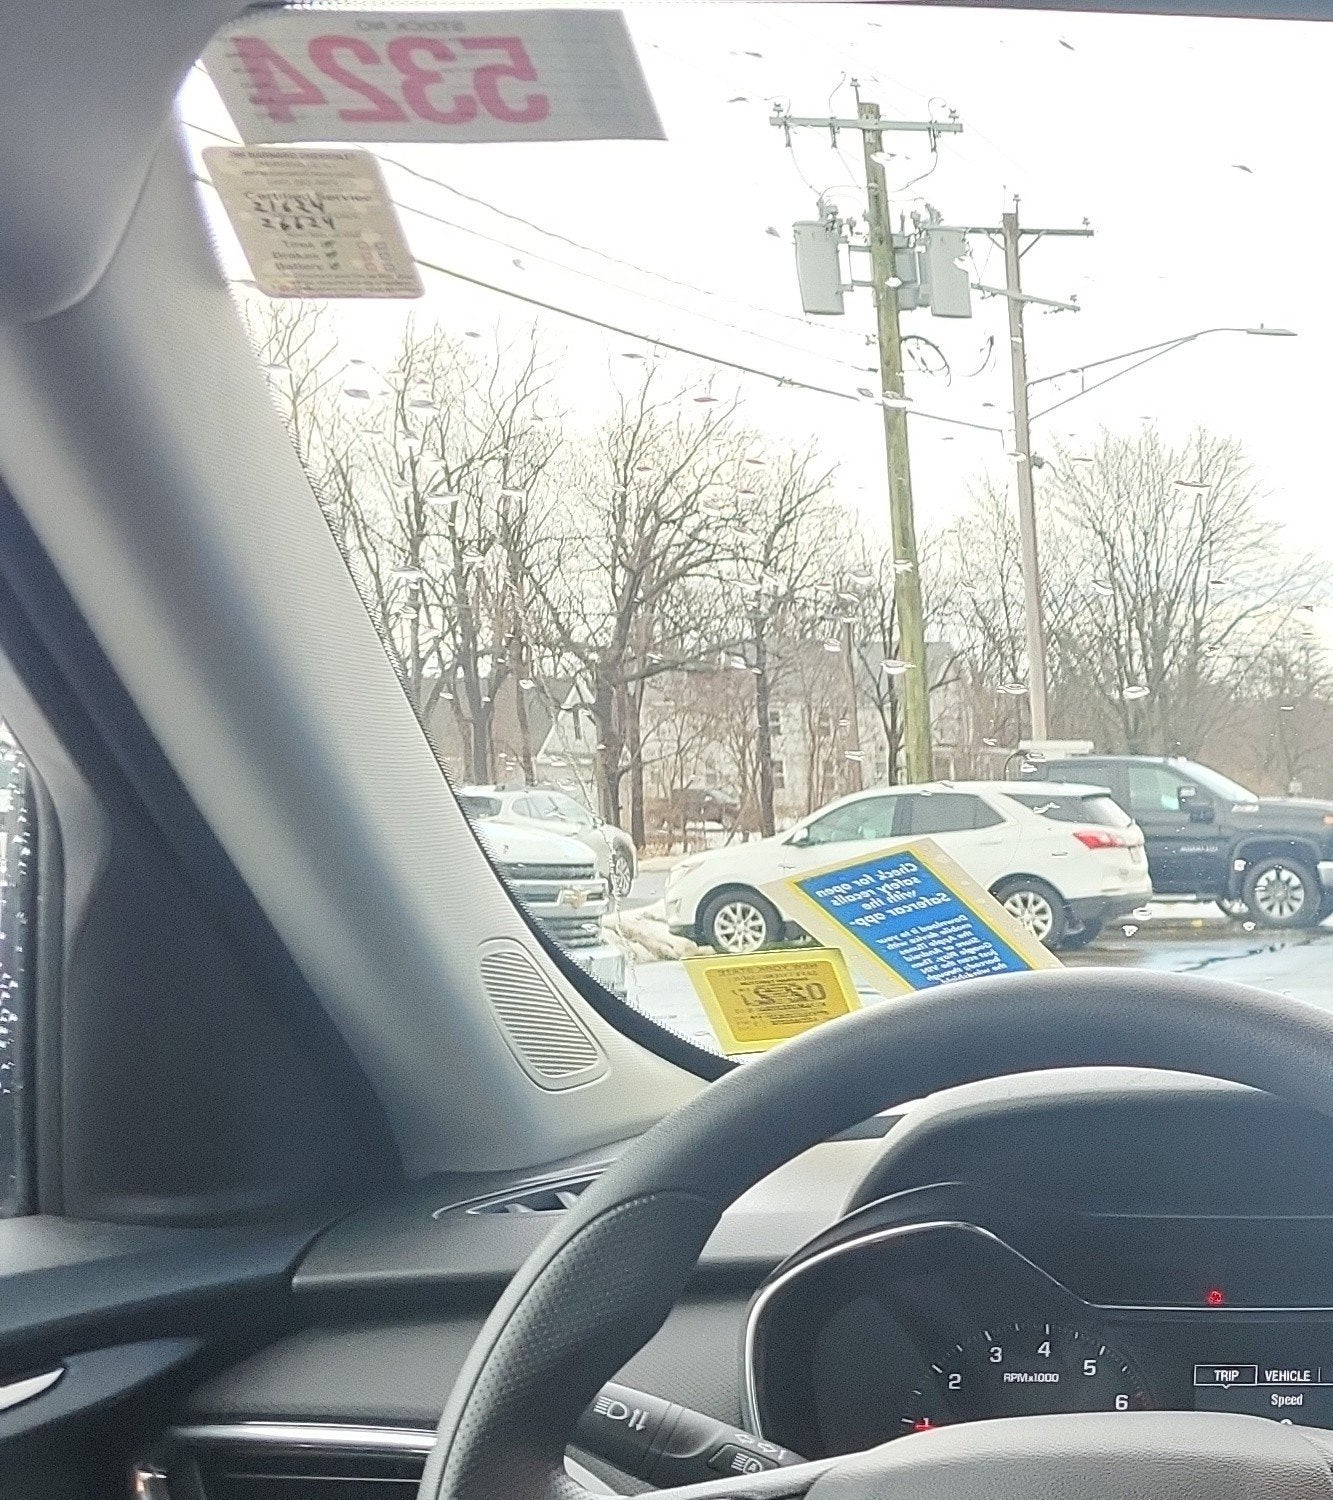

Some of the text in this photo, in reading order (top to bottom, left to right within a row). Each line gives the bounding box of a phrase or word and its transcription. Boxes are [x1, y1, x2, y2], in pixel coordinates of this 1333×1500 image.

[990, 1347, 1002, 1363] 3
[1038, 1342, 1051, 1357] 4
[1084, 1360, 1097, 1376] 5
[1214, 1370, 1240, 1382] TRIP
[1265, 1370, 1311, 1382] VEHICLE
[949, 1373, 961, 1390] 2
[1115, 1395, 1128, 1411] 6
[1271, 1393, 1303, 1407] Speed
